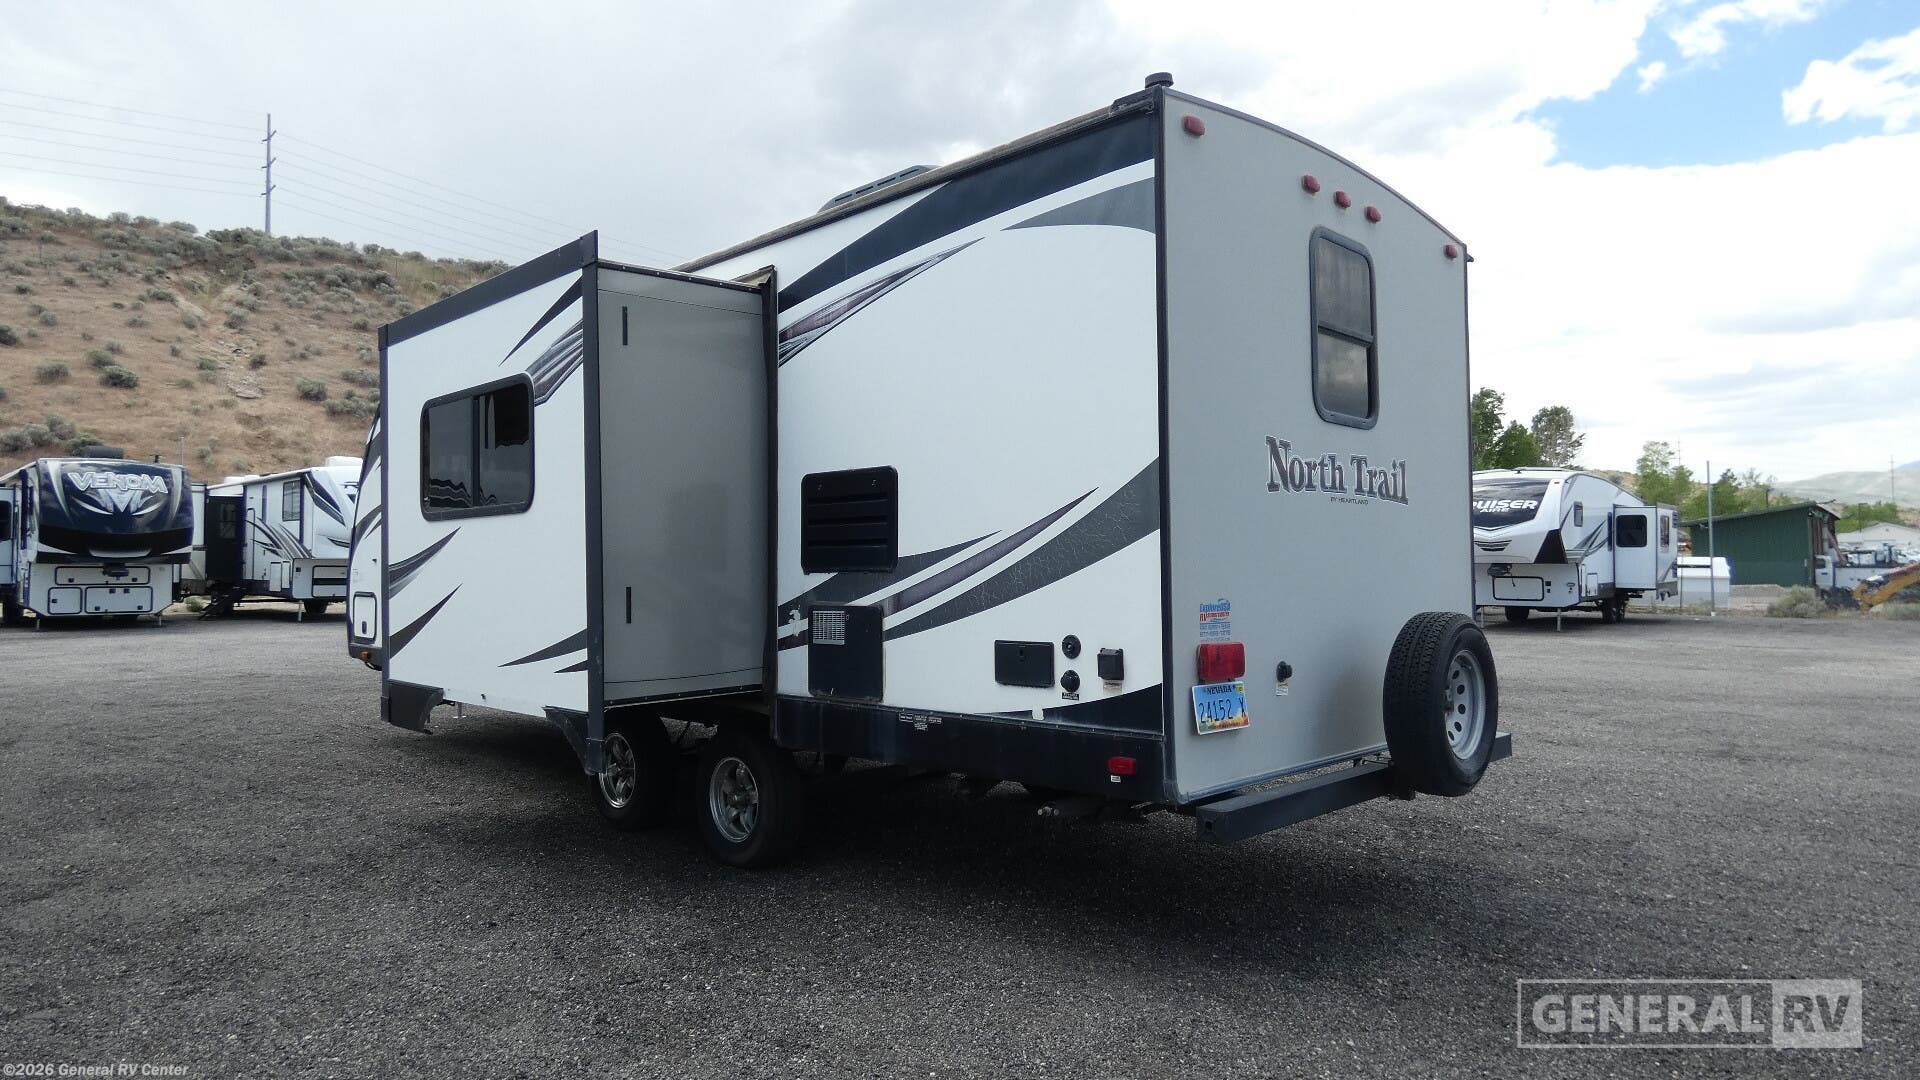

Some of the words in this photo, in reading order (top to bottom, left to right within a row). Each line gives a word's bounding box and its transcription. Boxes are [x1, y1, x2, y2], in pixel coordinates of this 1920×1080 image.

[1266, 435, 1347, 494] North
[1350, 454, 1409, 505] Trail
[68, 472, 168, 493] VENOM
[1207, 685, 1232, 695] NEVADA
[1198, 699, 1233, 724] 24152
